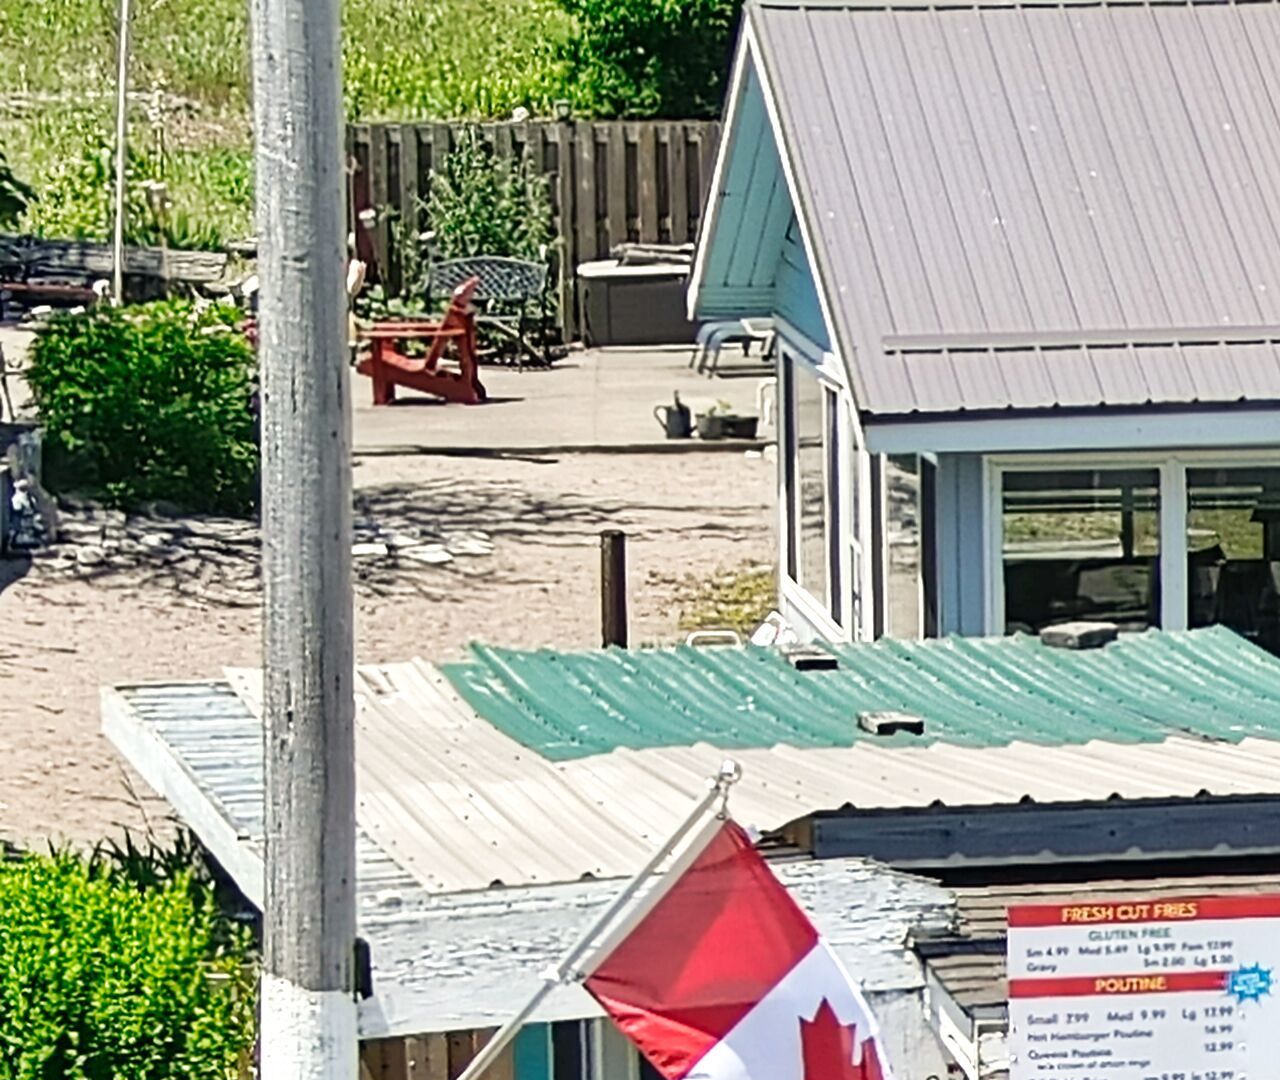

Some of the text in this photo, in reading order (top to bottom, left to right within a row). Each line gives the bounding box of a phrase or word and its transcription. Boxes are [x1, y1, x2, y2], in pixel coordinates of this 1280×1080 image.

[1062, 903, 1197, 922] FRESH CUT FRIES
[1089, 928, 1171, 941] GLUTEN FREE
[1095, 977, 1167, 992] POUTINE
